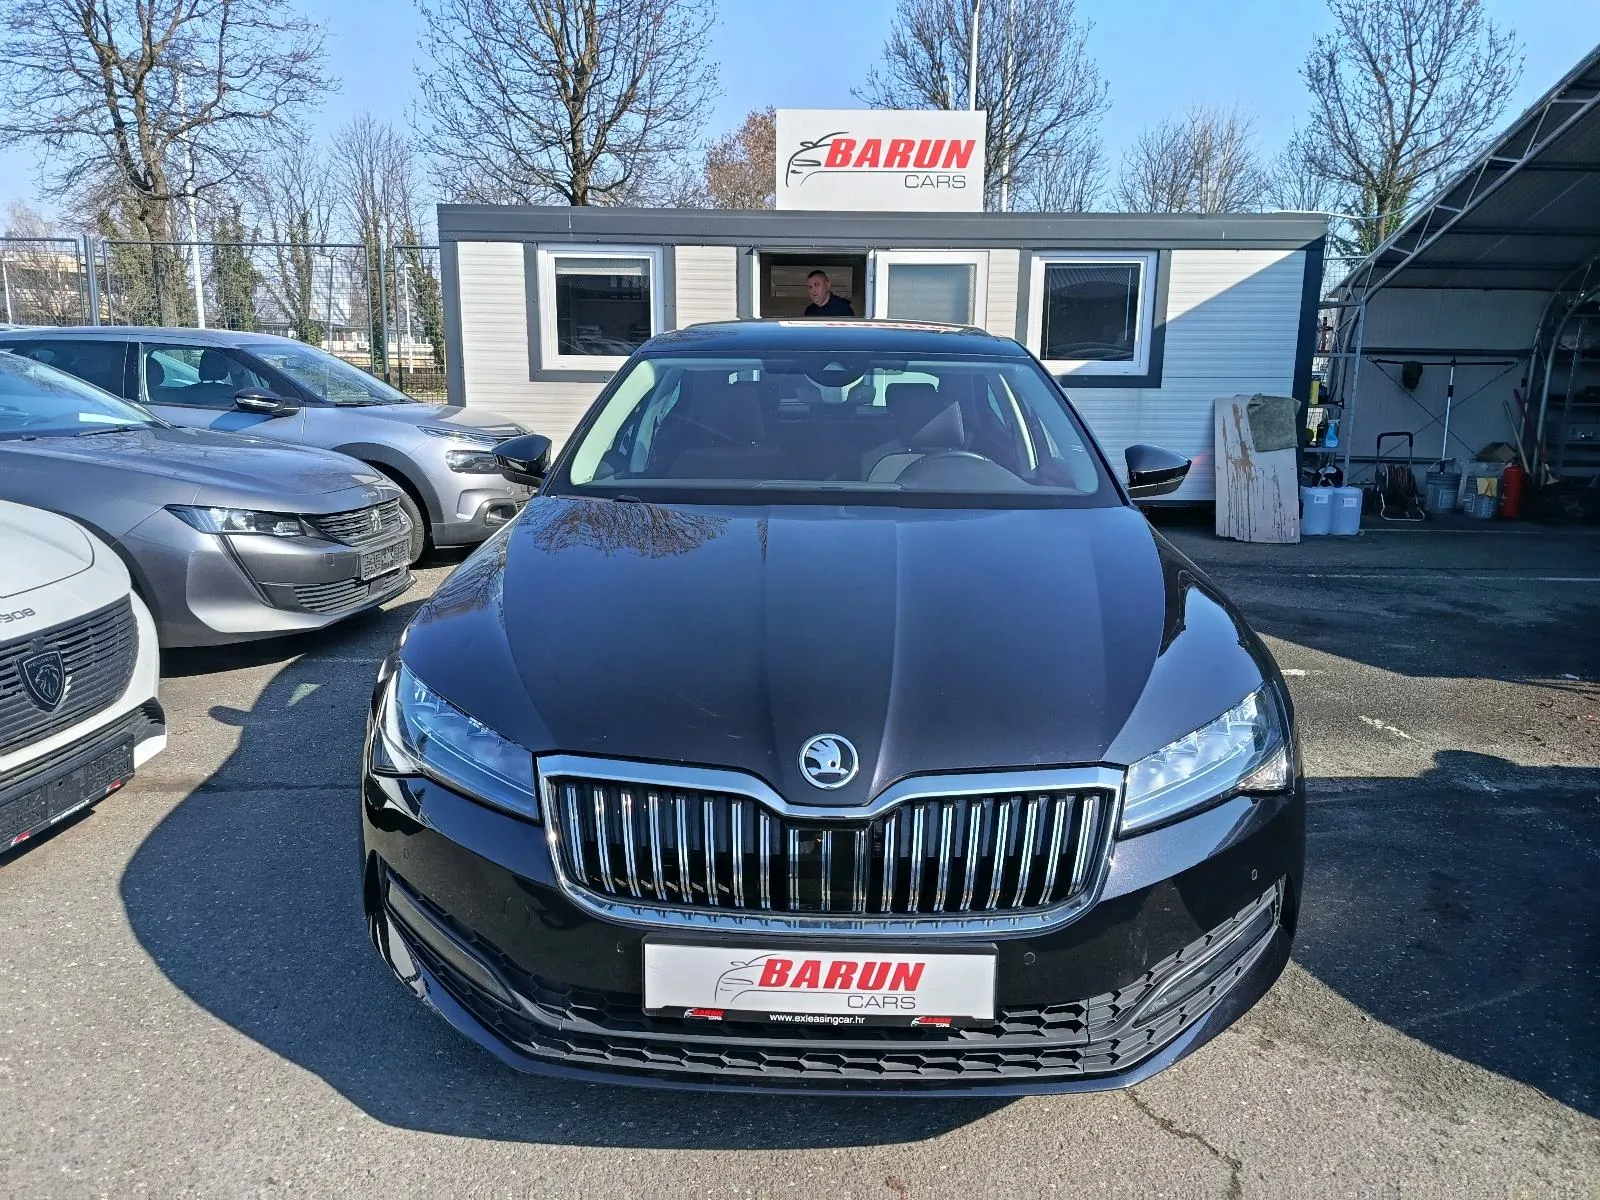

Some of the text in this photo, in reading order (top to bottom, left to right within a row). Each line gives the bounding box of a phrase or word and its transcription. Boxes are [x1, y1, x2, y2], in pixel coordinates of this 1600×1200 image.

[824, 138, 976, 169] BARUN
[904, 174, 967, 189] CARS
[758, 958, 925, 992] BARUN
[846, 994, 917, 1010] CARS
[769, 1013, 866, 1026] www.exleasingcar.hr
